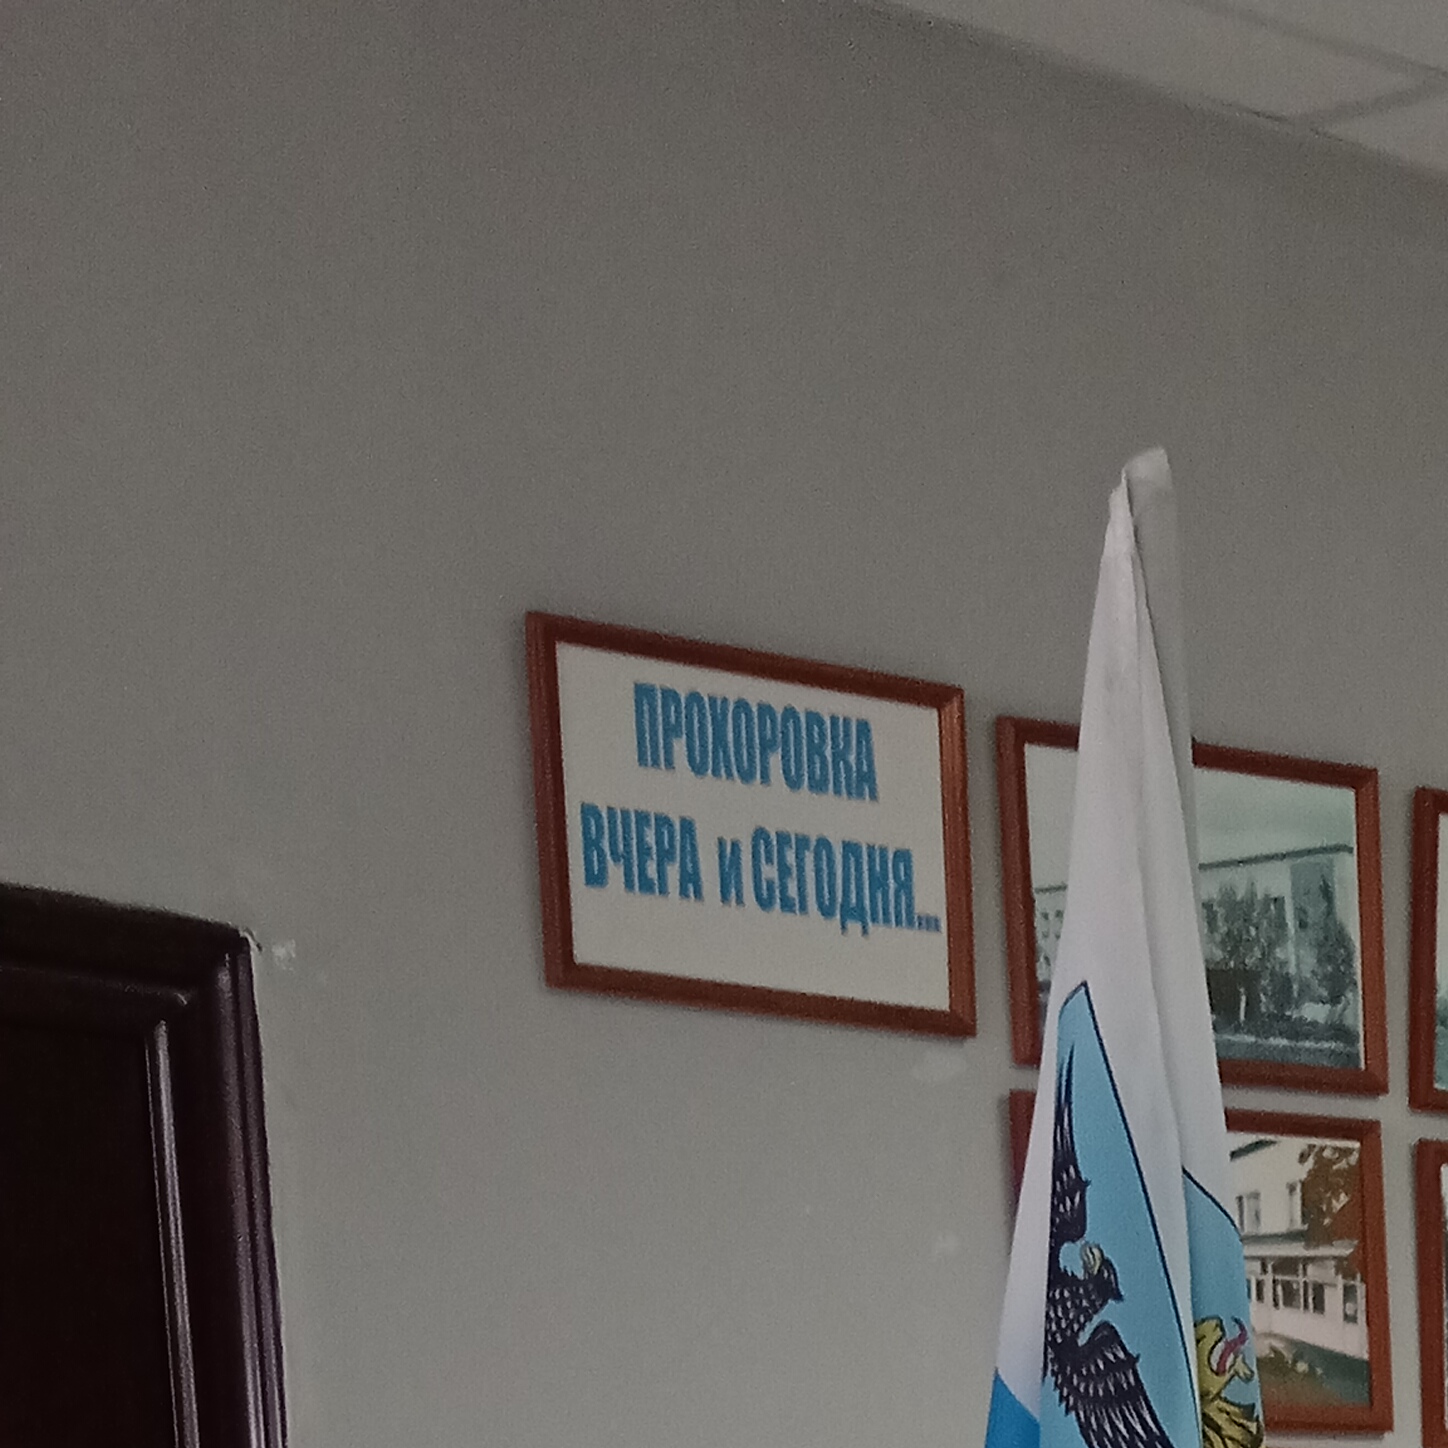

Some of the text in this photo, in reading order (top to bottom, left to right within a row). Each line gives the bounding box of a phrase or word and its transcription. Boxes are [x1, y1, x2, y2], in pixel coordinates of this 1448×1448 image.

[634, 682, 879, 803] ПРОХОРОВКА
[580, 802, 943, 938] ВЧЕРА и СЕГОДНЯ...
